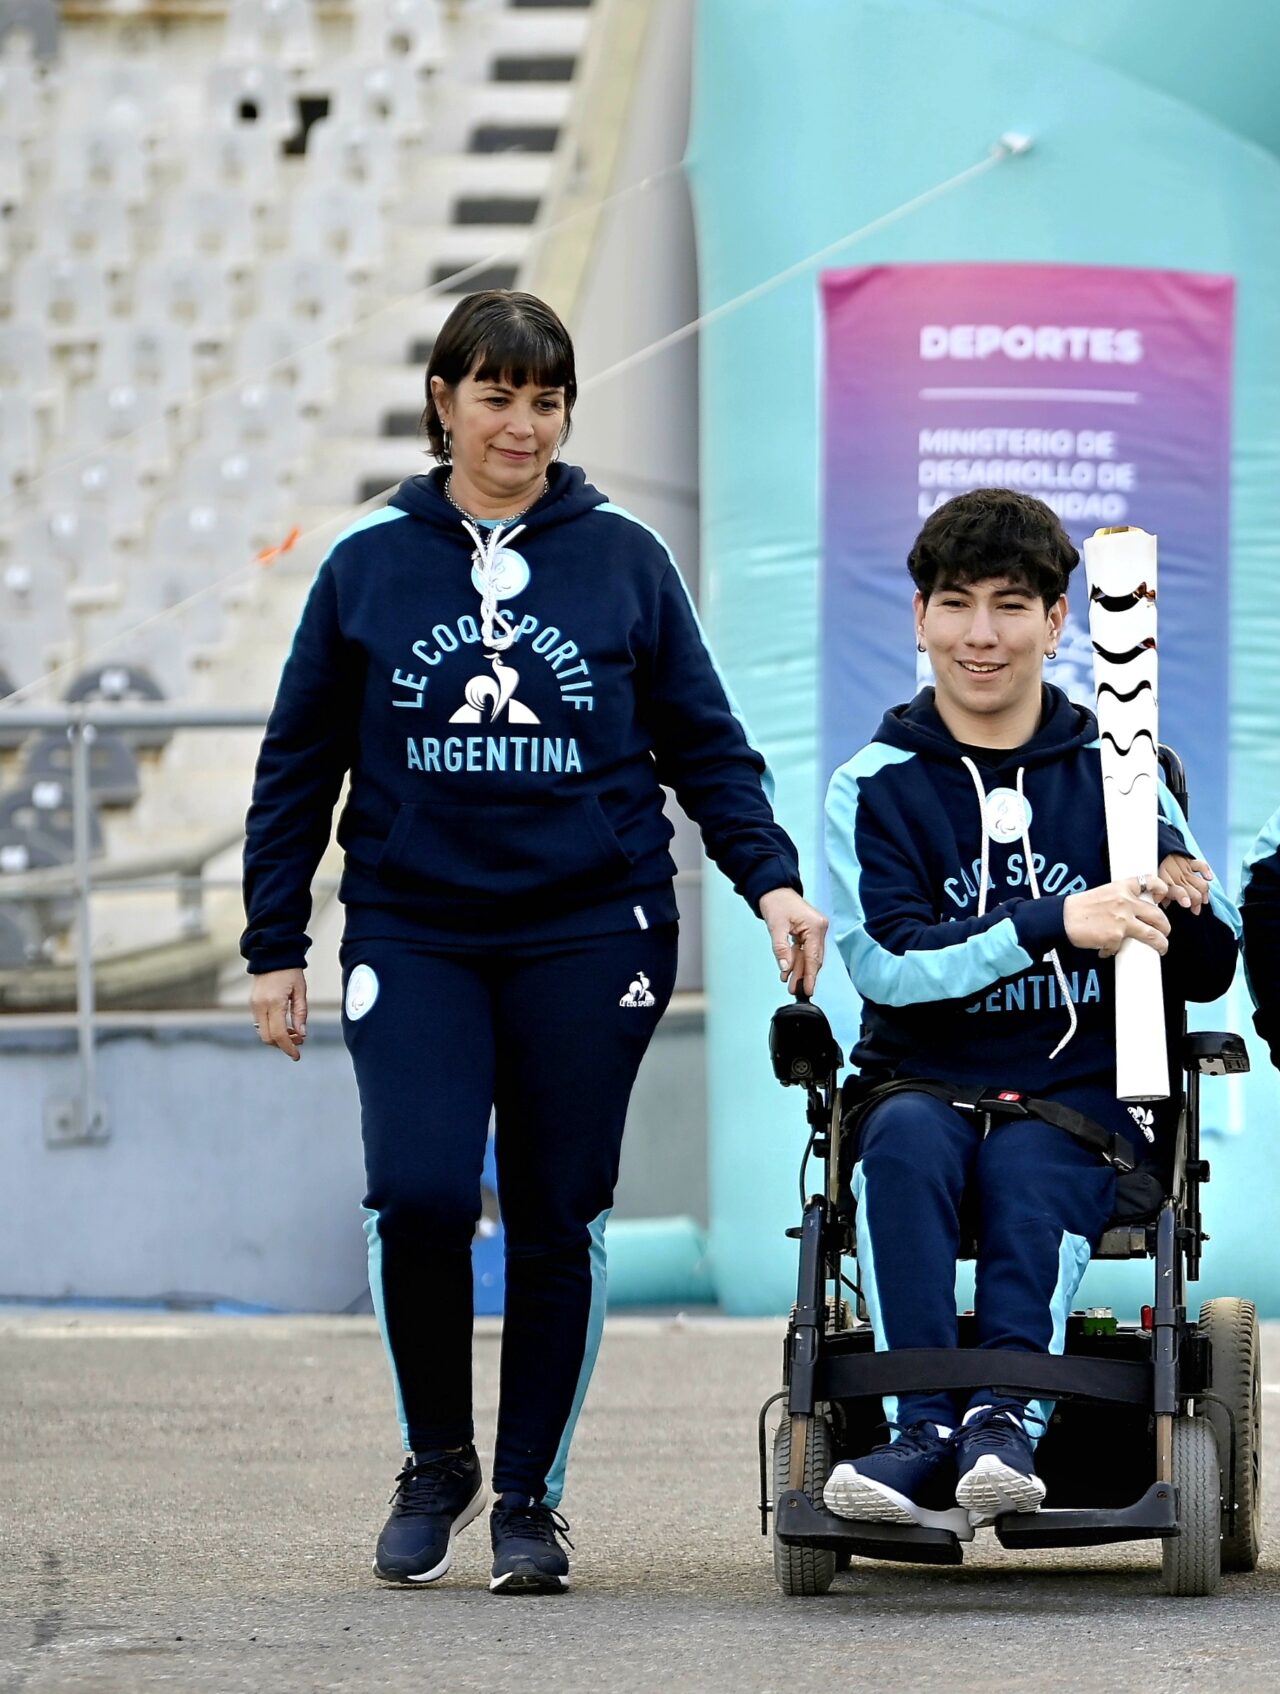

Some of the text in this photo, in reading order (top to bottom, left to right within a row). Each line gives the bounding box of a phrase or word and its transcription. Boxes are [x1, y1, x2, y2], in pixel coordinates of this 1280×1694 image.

[919, 325, 1143, 363] DEPORTES
[918, 427, 1118, 459] MINISTERIO DE
[918, 459, 1138, 492] DESARROLLO DE
[392, 668, 429, 709] LE
[412, 615, 482, 666] COQ
[406, 736, 583, 773] ARGENTINA
